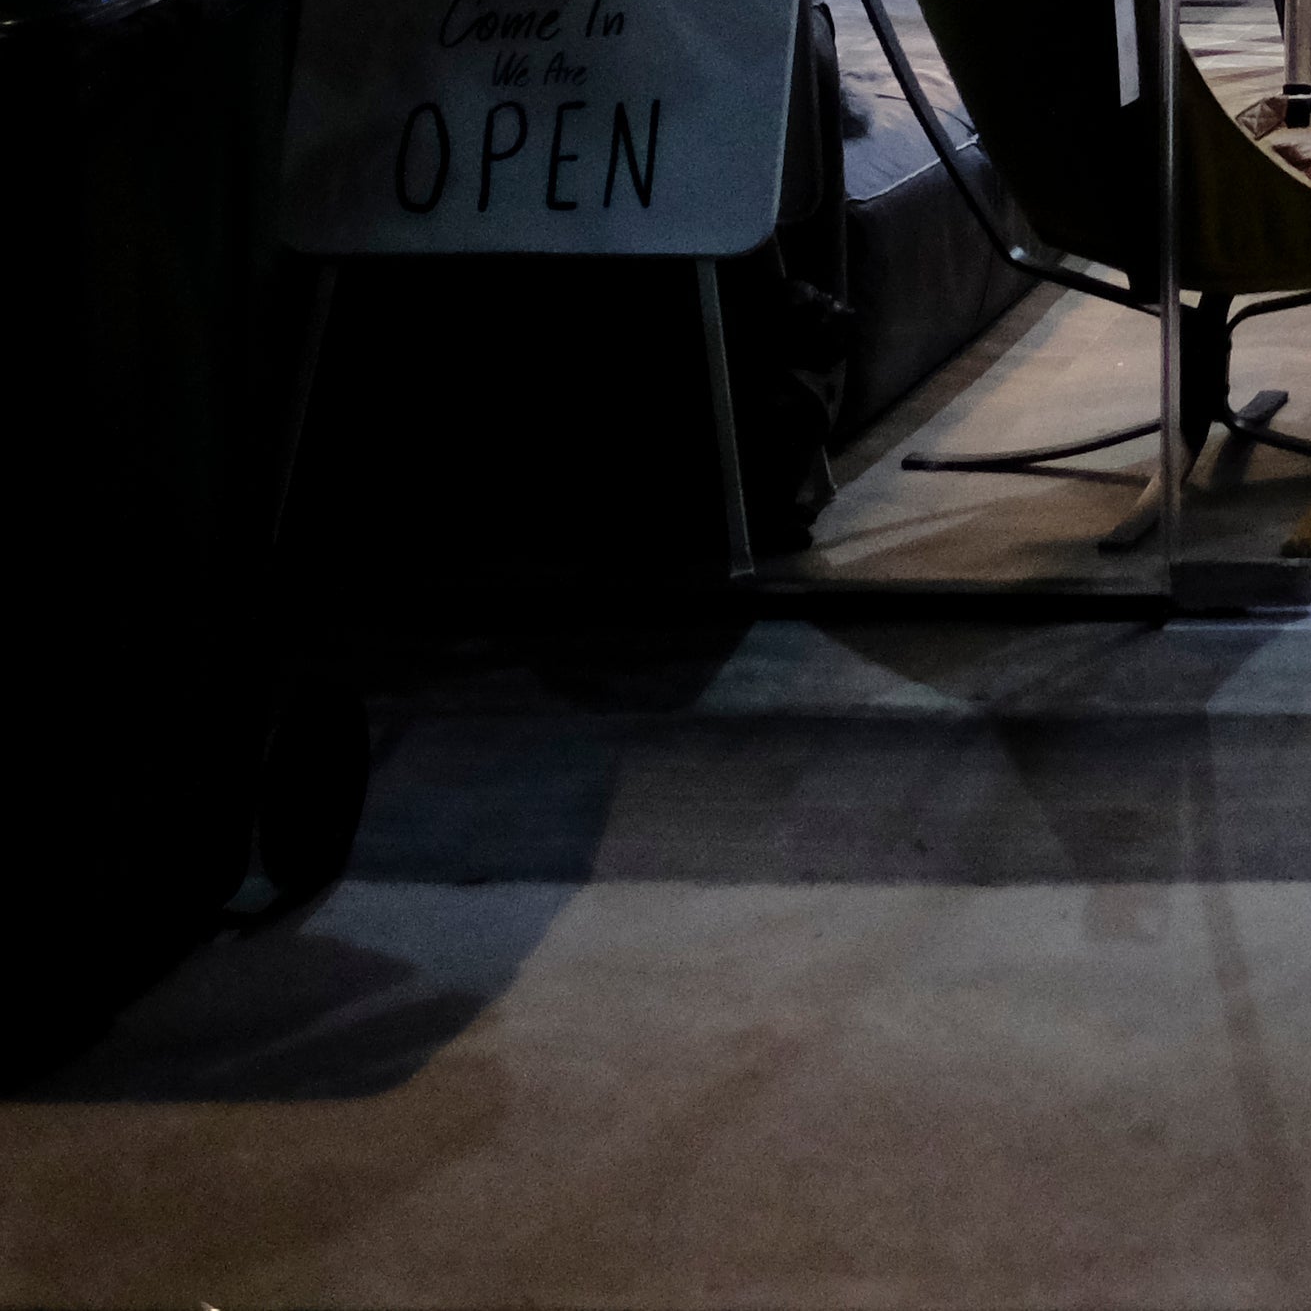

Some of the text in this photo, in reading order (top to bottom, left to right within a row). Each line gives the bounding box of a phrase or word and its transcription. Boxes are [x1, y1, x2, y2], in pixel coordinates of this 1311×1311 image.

[492, 50, 588, 88] We Are
[395, 98, 661, 214] OPEN
